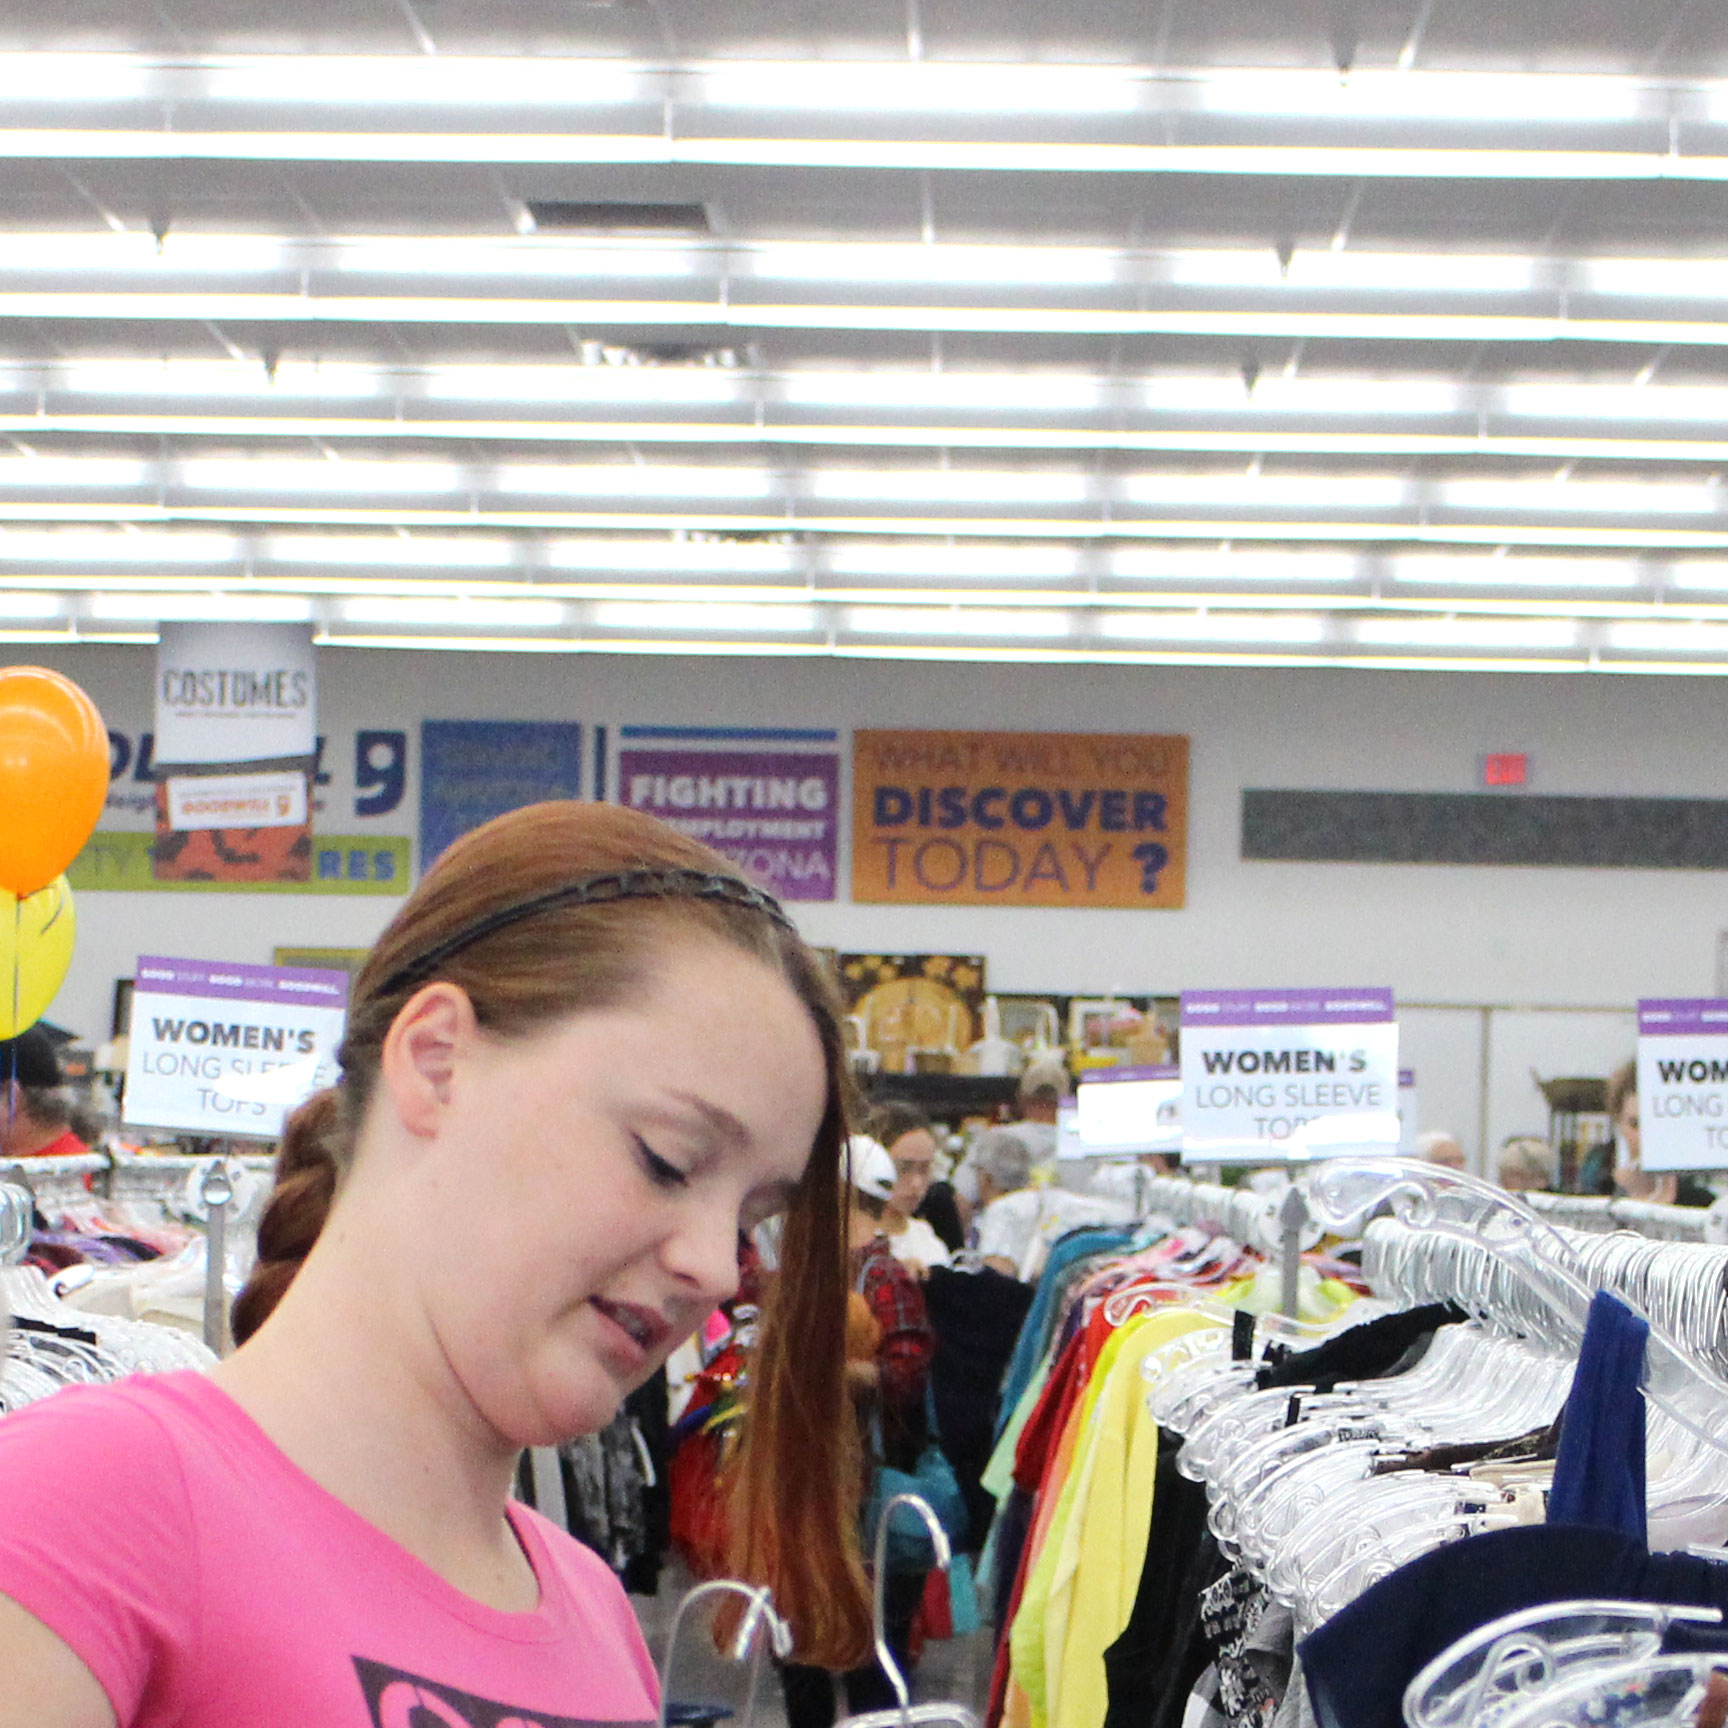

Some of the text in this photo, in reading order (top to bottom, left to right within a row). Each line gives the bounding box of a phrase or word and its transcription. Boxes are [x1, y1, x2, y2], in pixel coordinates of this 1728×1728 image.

[162, 670, 307, 708] COSTUMES
[874, 743, 1169, 778] WHAT WILL YOU
[630, 775, 828, 811] FIGHTING
[874, 786, 1167, 831] DISCOVER
[318, 850, 395, 881] RES
[874, 837, 1113, 892] TODAY
[152, 1017, 316, 1054] WOMEN'S
[142, 1051, 221, 1080] LONG
[1203, 1050, 1367, 1075] WOMEN'S
[1195, 1083, 1382, 1108] LONG SLEEVE
[1653, 1093, 1723, 1118] LONG
